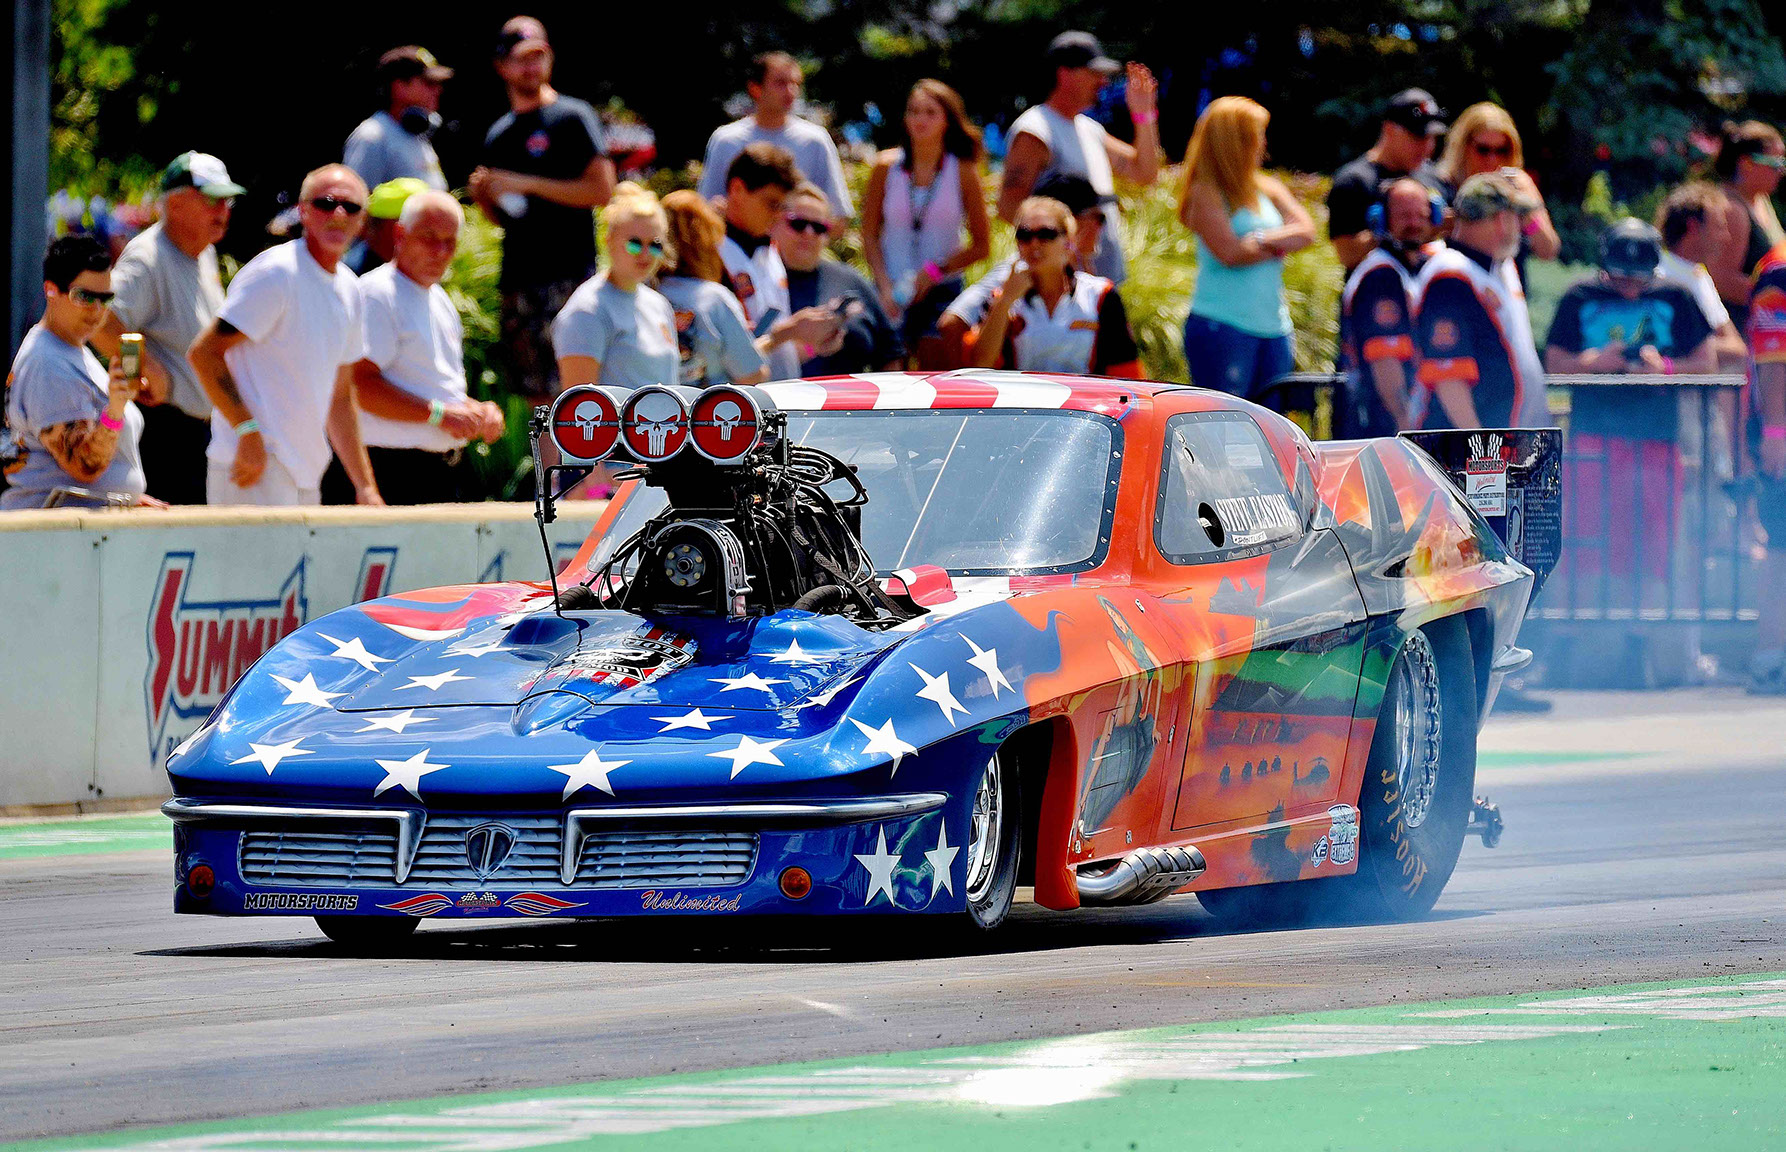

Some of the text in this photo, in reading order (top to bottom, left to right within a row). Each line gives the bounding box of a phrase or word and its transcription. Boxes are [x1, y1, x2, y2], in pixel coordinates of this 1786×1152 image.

[1468, 459, 1504, 472] MOTORSPORTS
[1312, 843, 1328, 857] KB
[244, 893, 359, 910] MOTORSPORTS
[641, 890, 742, 911] Unlimited
